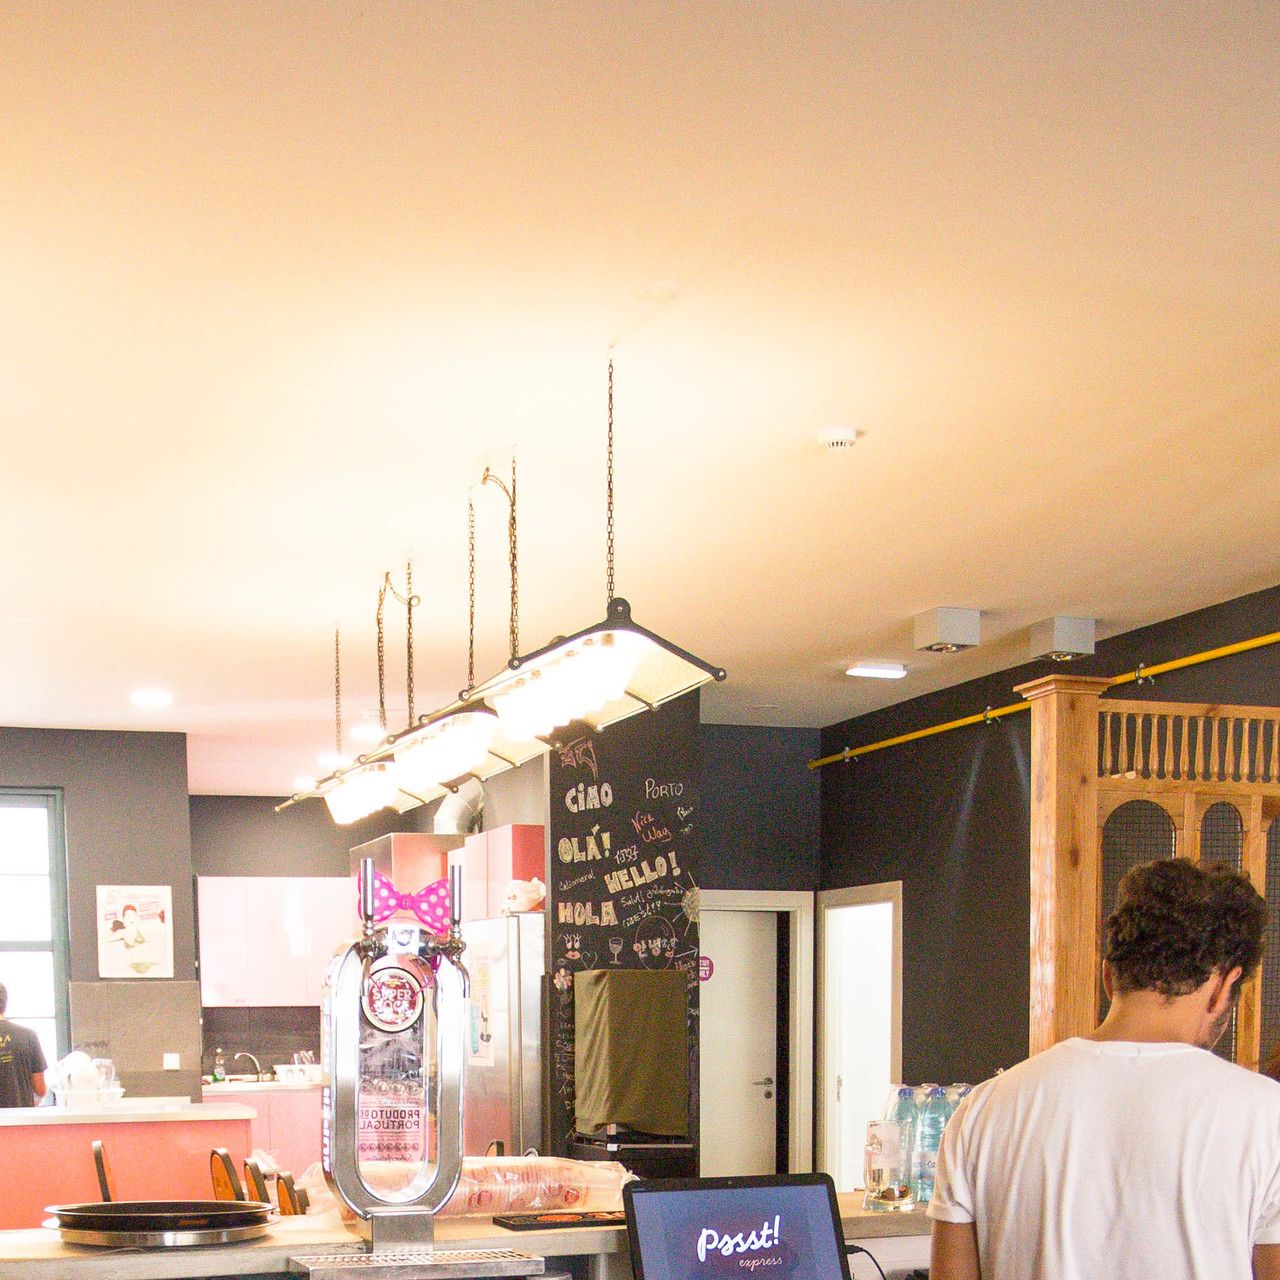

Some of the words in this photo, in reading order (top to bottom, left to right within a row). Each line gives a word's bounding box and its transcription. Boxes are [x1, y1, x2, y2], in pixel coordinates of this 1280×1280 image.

[645, 778, 683, 799] PORTO
[558, 823, 611, 864] OLÁ!
[604, 851, 681, 894] HELLO!
[558, 901, 619, 927] HOLA
[739, 1257, 783, 1272] express
